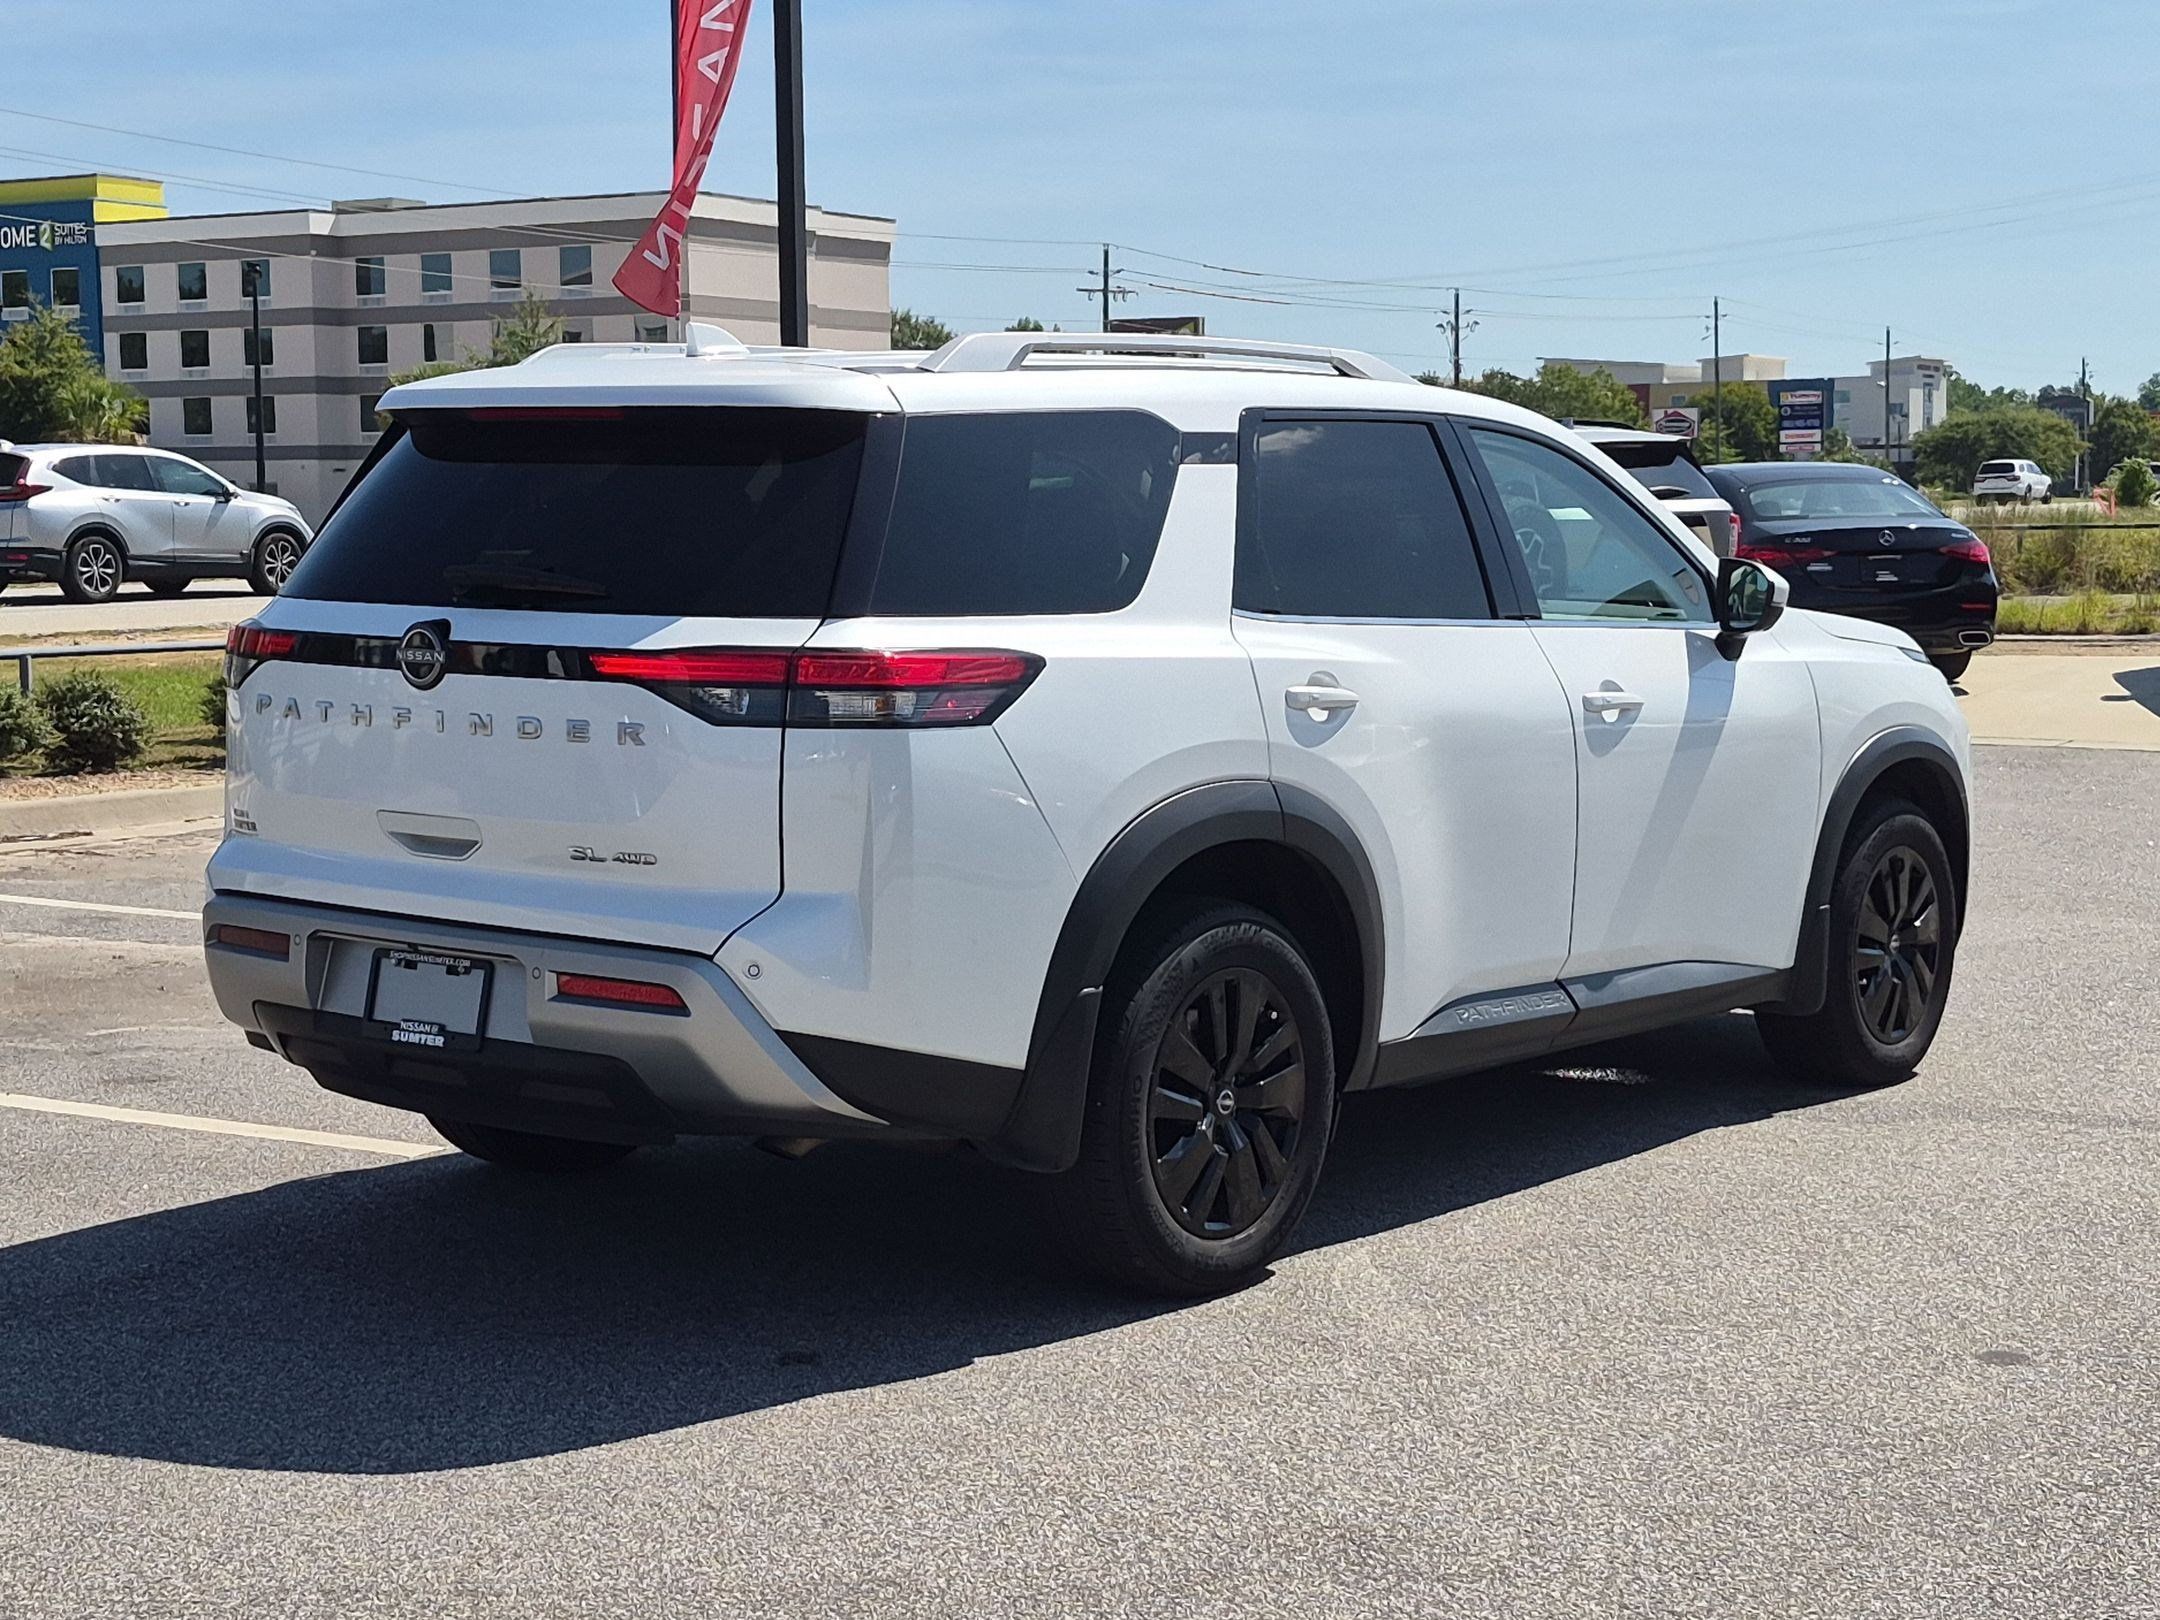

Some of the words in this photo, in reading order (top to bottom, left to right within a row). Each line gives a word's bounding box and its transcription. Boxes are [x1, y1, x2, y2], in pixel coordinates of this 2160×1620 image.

[40, 222, 53, 252] 2
[54, 222, 88, 236] SUITES
[395, 648, 446, 664] NISSAN
[256, 692, 647, 748] PATHFINDER
[567, 845, 607, 863] SL
[612, 851, 658, 866] 4WD
[1455, 991, 1569, 1025] PATHFINDER
[400, 1020, 432, 1034] NISSAN
[391, 1029, 445, 1048] SUMTER
